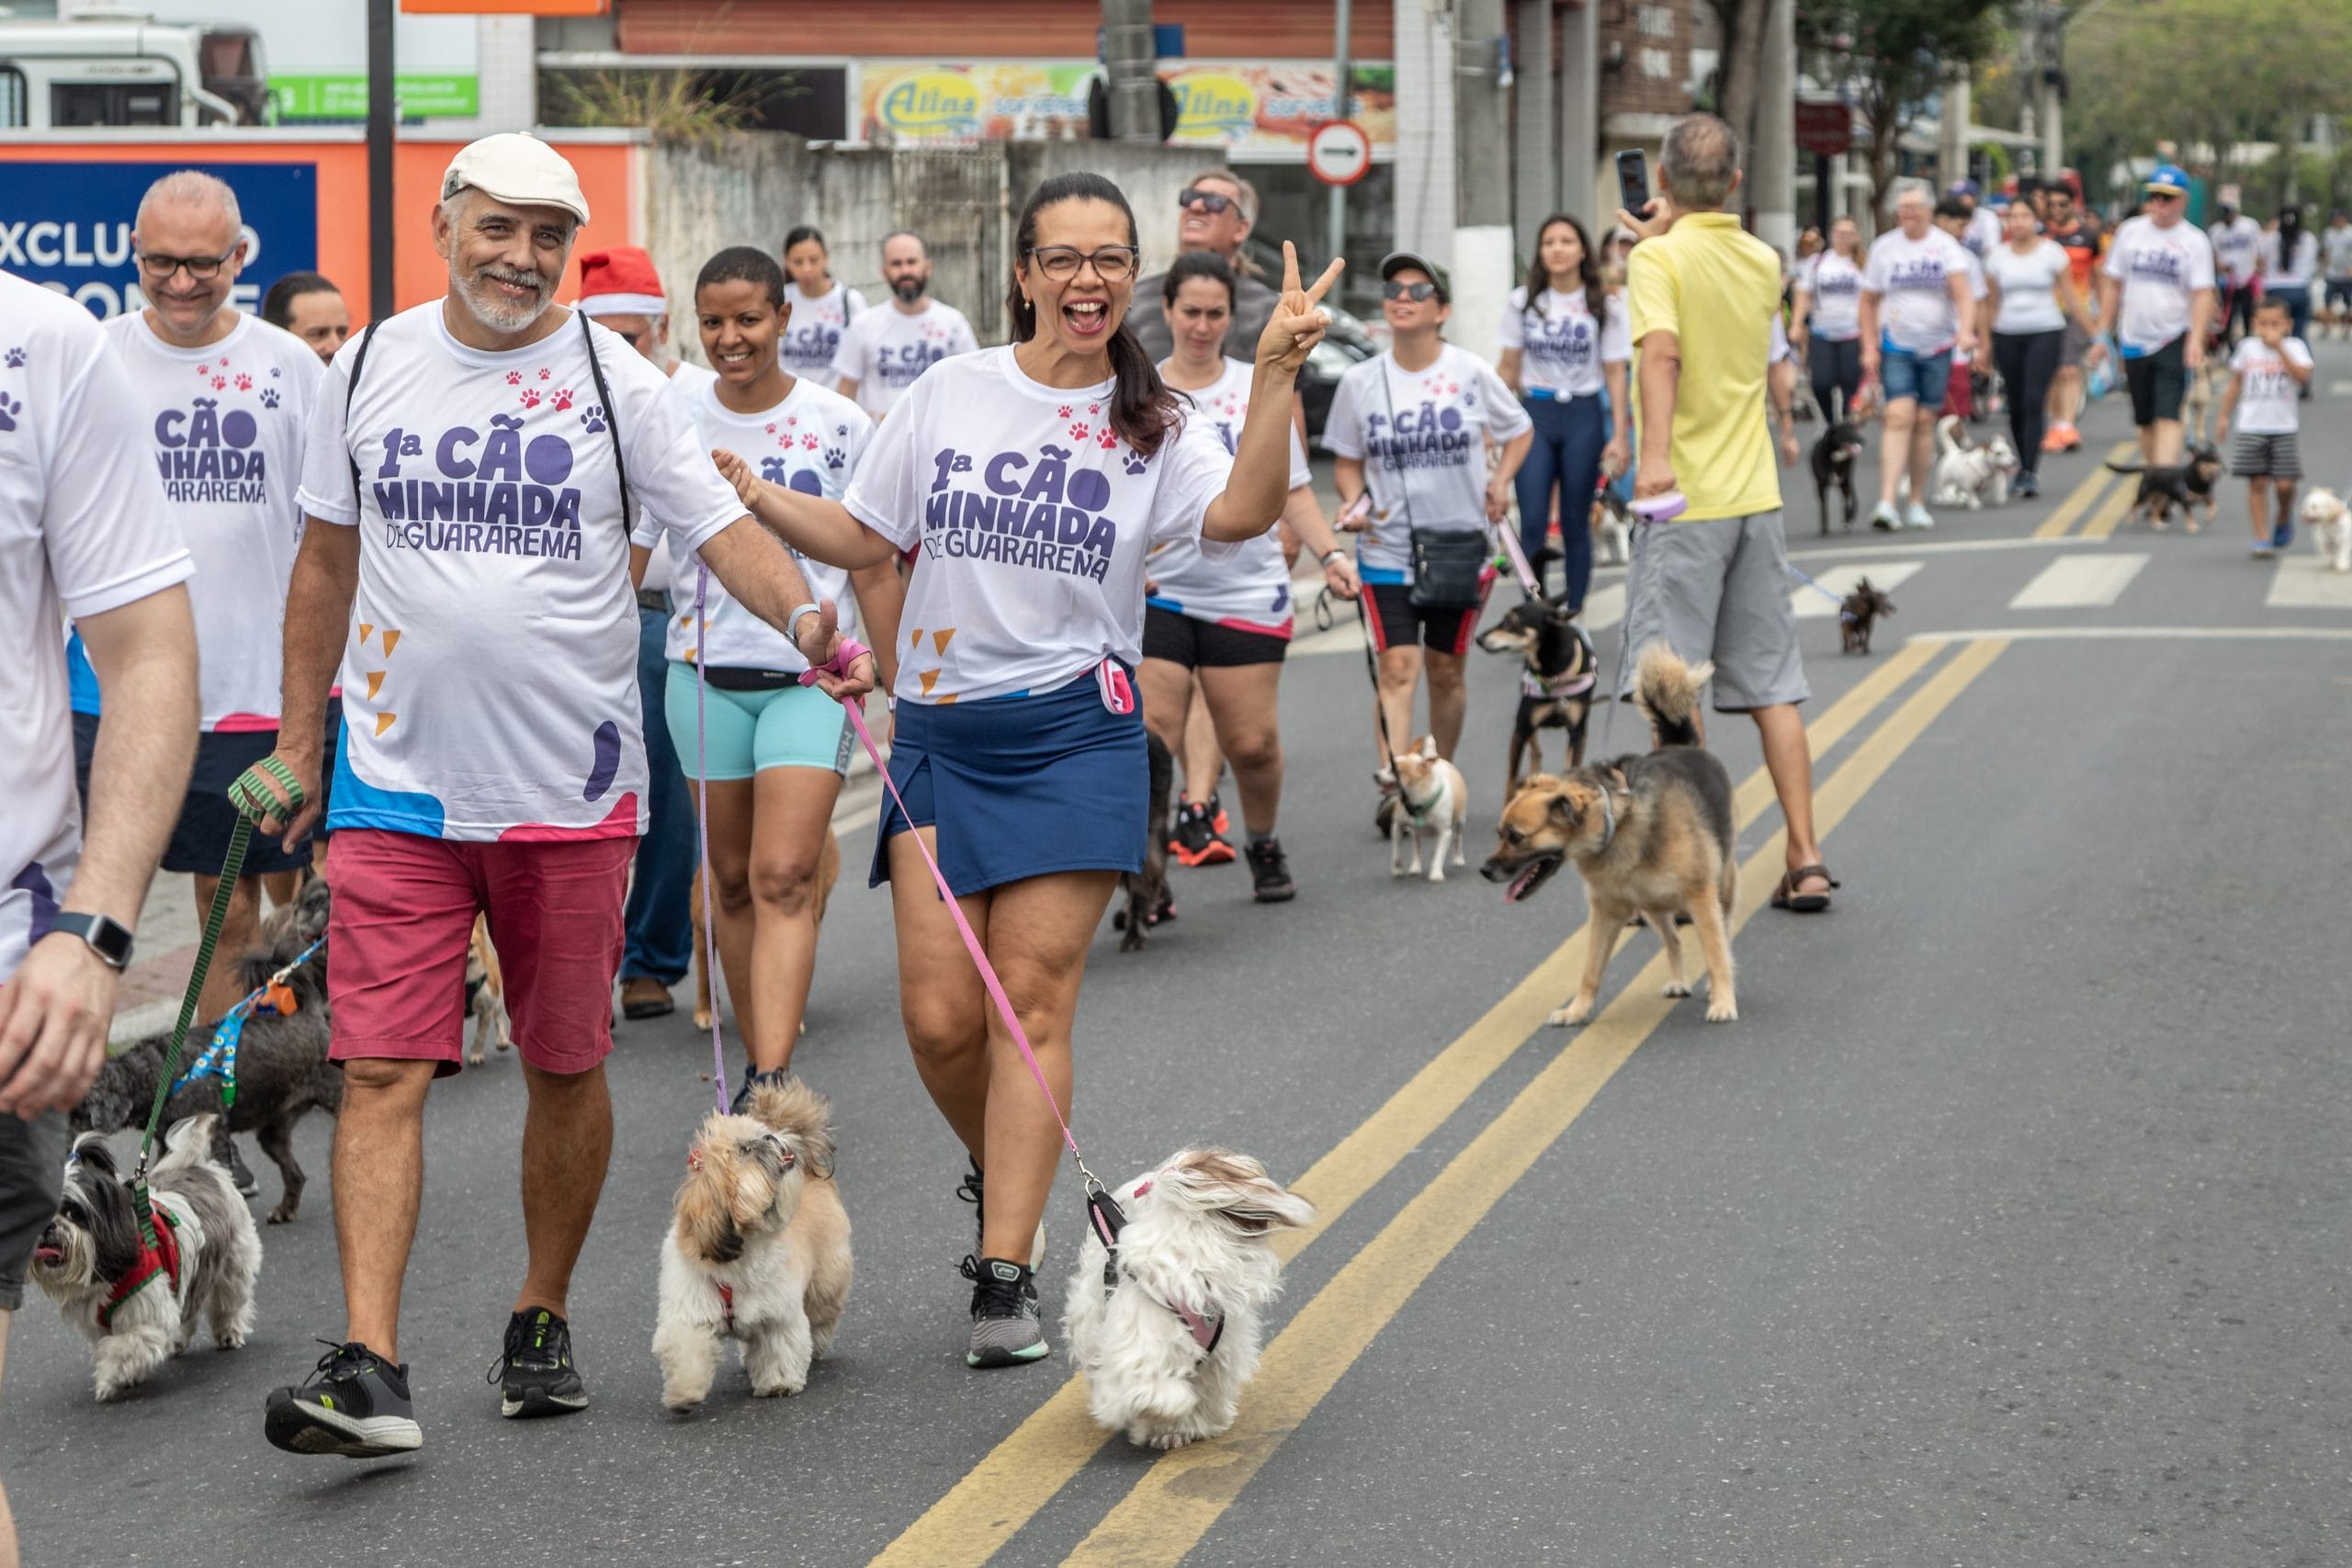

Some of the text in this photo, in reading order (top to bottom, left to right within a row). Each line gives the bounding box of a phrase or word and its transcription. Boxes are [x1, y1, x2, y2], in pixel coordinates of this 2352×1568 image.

[884, 81, 976, 127] Alina
[155, 397, 257, 448] CÃO
[1396, 400, 1462, 434] CÃO
[435, 413, 573, 486] CÃO
[1367, 430, 1470, 457] MINHADA
[154, 450, 266, 481] NHADA
[761, 456, 822, 497] ÃO
[984, 445, 1111, 512] CÃO
[164, 480, 266, 503] ARAREMA
[373, 479, 582, 530] MINHADA
[404, 522, 582, 560] GUARAREMA
[926, 491, 1115, 558] MINHADA
